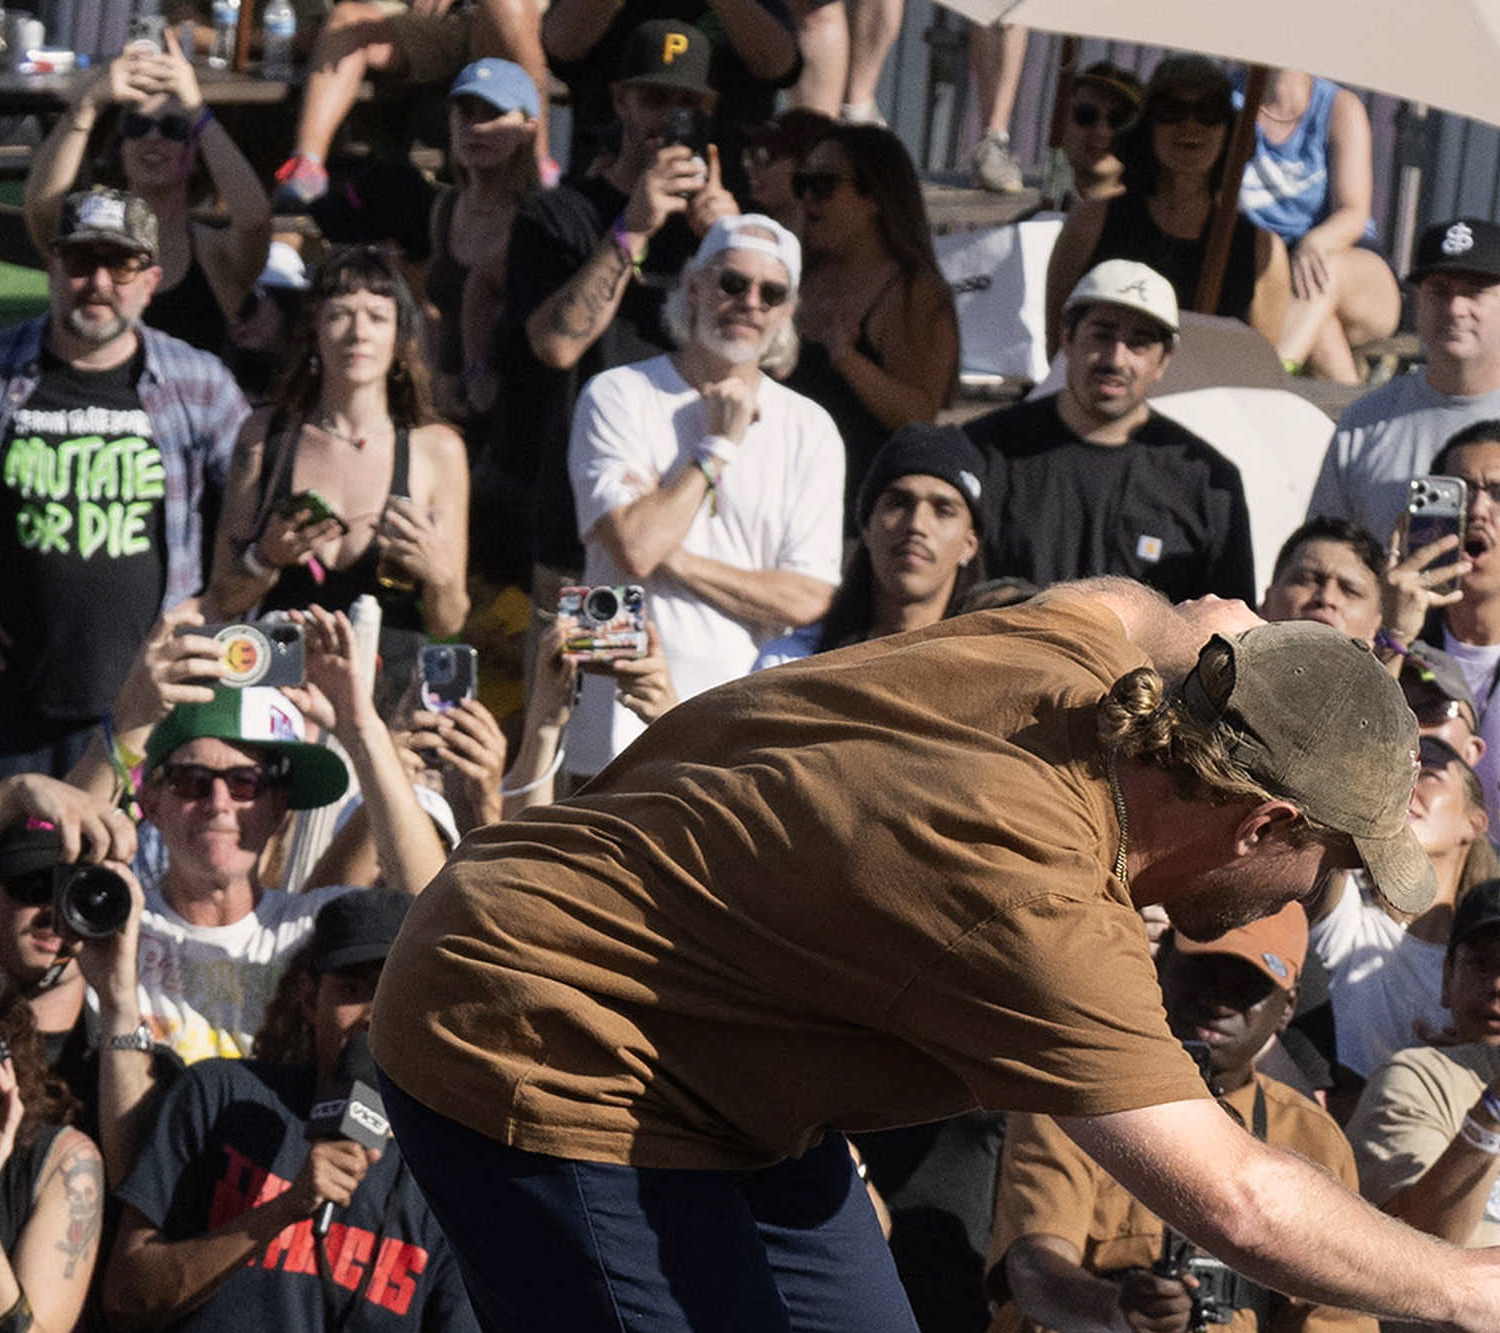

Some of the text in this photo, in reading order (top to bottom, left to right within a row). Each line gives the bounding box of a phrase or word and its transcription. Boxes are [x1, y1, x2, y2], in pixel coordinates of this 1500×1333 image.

[662, 32, 689, 63] P
[4, 434, 166, 502] MUTATE
[16, 500, 154, 560] OR DIE
